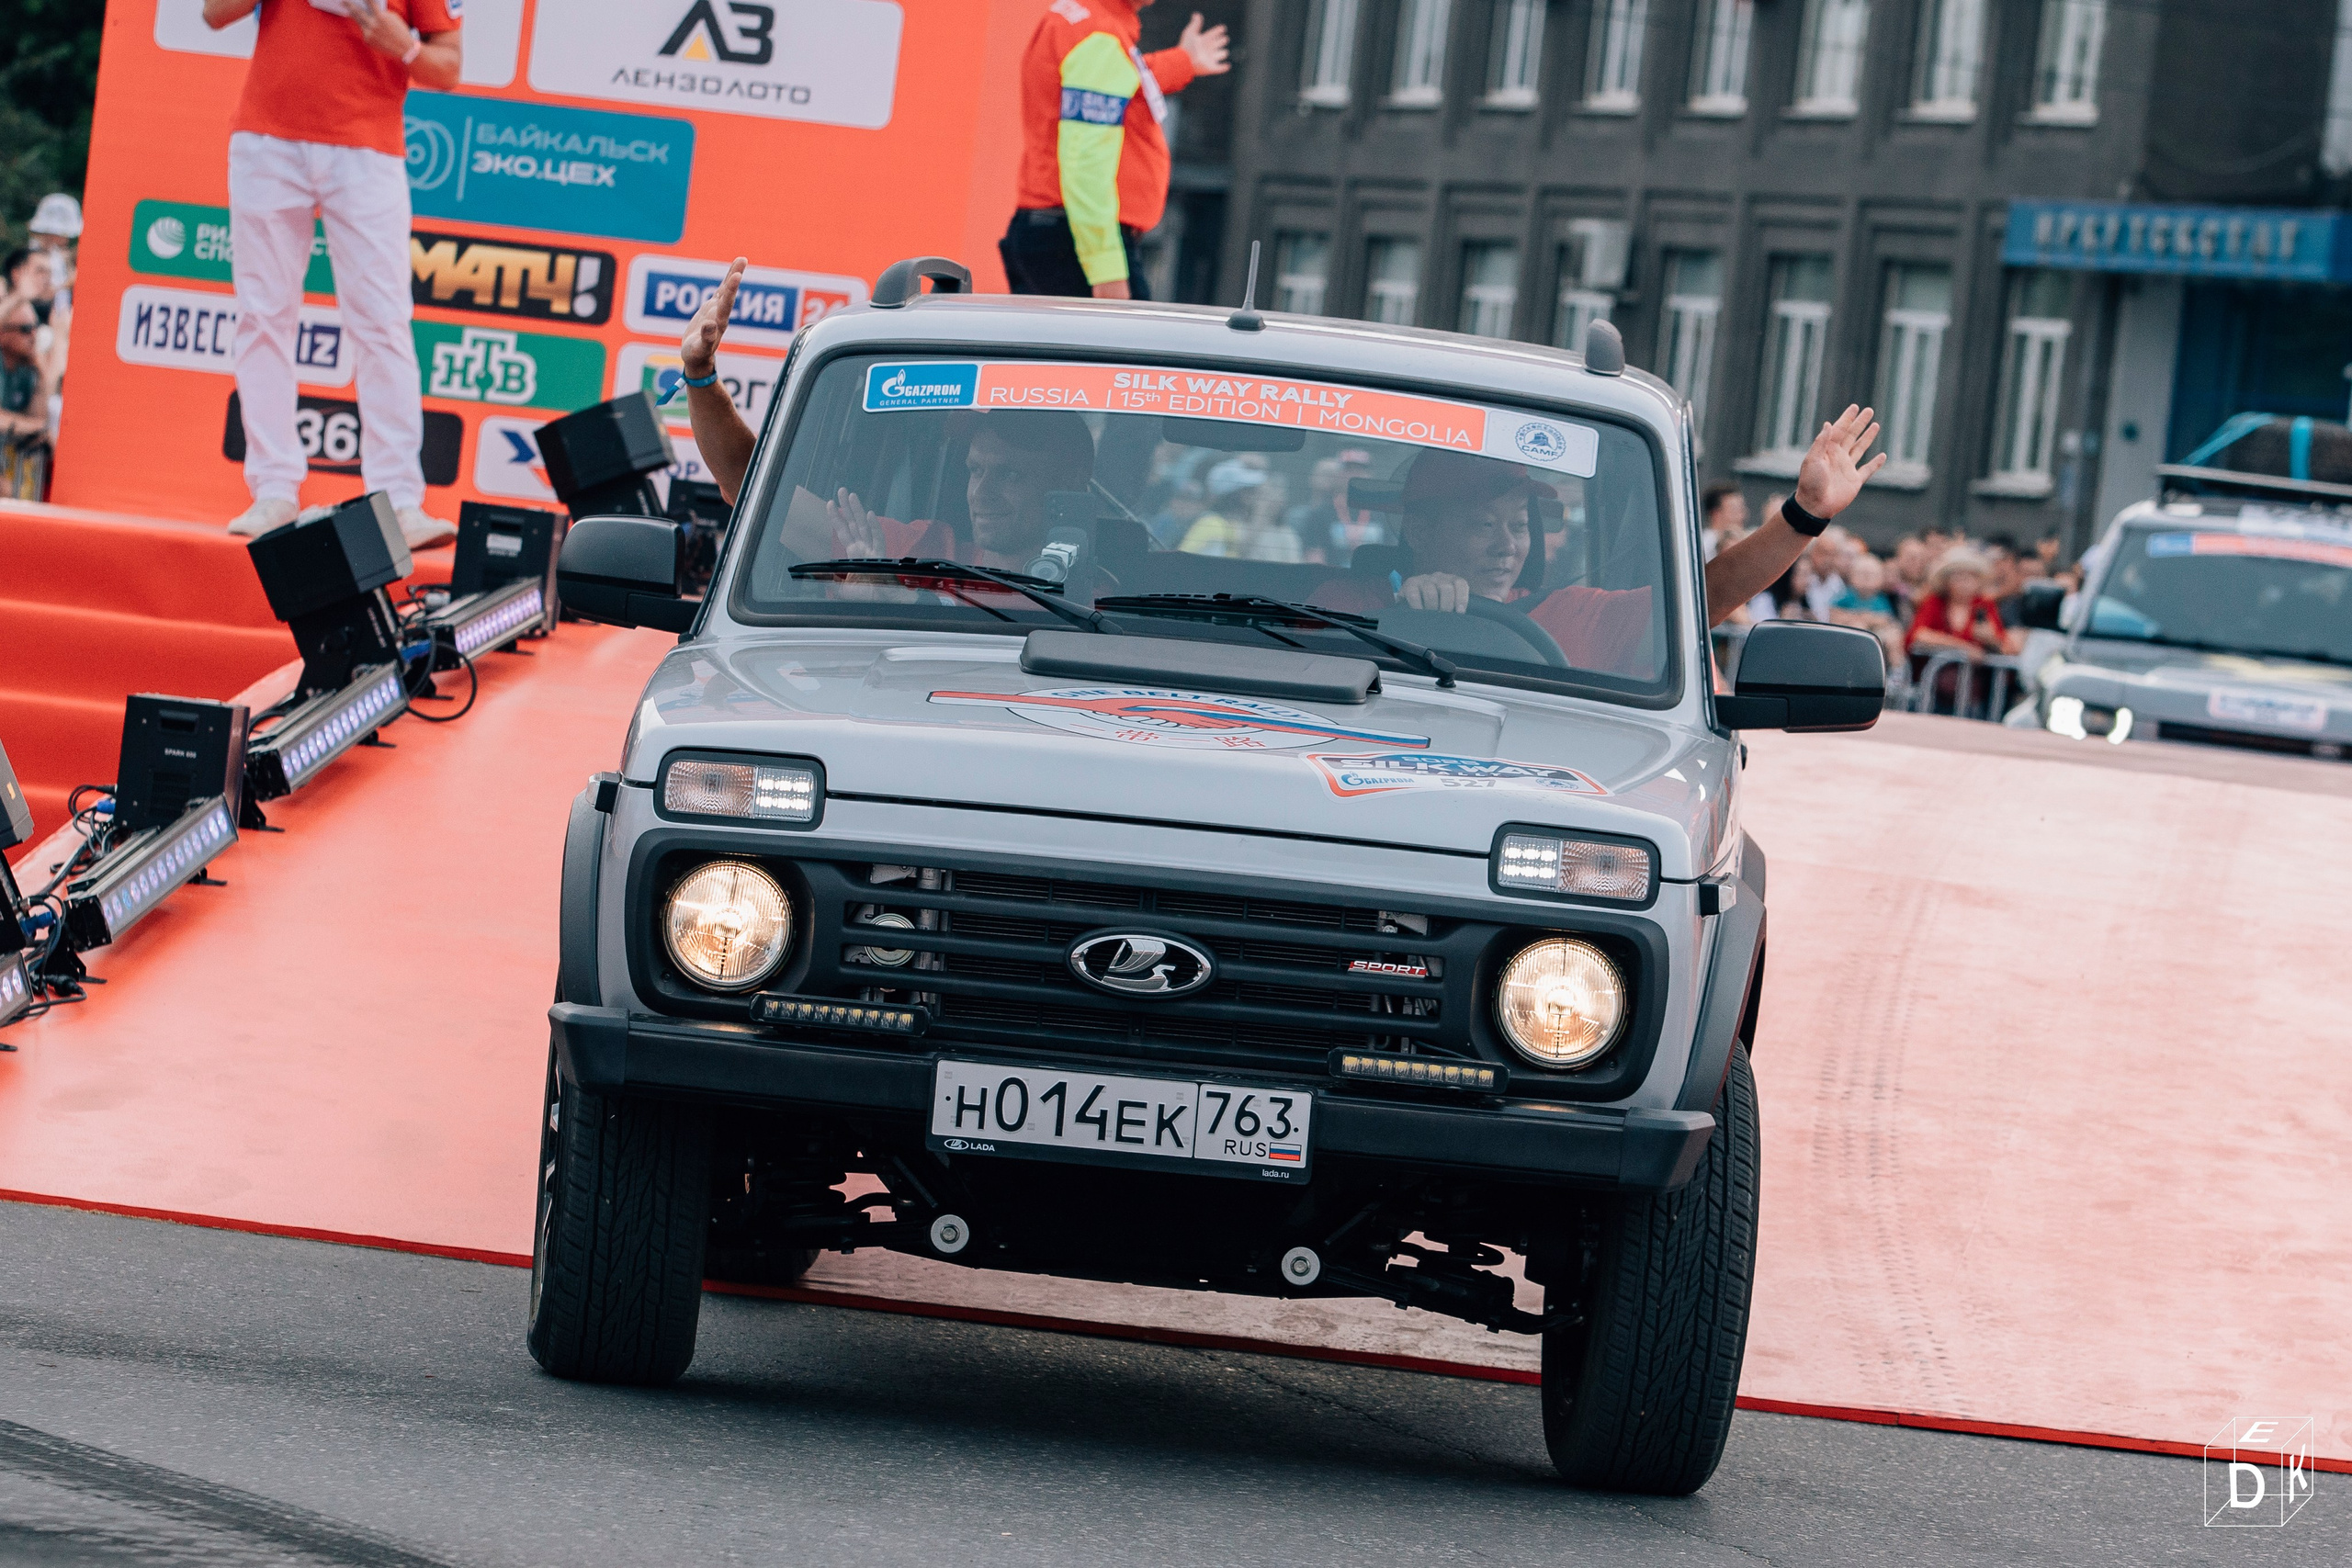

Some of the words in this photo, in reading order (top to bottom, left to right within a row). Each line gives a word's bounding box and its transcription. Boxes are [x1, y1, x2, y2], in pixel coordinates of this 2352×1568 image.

[611, 68, 811, 105] ЛЕНЗОЛОТО
[476, 123, 670, 164] БАЙКАЛЬСК
[471, 151, 616, 187] ЭКО.ЦЕХ
[197, 223, 232, 247] РИ
[411, 238, 602, 318] МАТЧ!
[655, 281, 786, 324] РОИЯ
[133, 302, 236, 356] ИЗВЕС
[434, 331, 532, 400] НТВ
[904, 384, 962, 397] GAZPROM
[989, 387, 1091, 405] RUSSIA
[1114, 372, 1178, 391] SILK
[1185, 377, 1254, 398] WAY
[1260, 384, 1353, 409] RALLY
[1120, 390, 1161, 408] 15th
[1169, 395, 1281, 420] EDITION
[1318, 409, 1474, 447] MONGOLIA
[1521, 446, 1559, 457] CAMF
[1122, 690, 1209, 700] BELT
[1213, 699, 1311, 719] RALLY
[1340, 759, 1453, 772] SILK
[1457, 765, 1558, 777] WAY
[1363, 777, 1415, 785] GAZPROM
[1440, 778, 1498, 787] 527
[1353, 960, 1426, 976] SPORT
[1205, 1090, 1294, 1139] 763
[970, 1143, 995, 1152] LADA
[1224, 1139, 1266, 1157] RUS
[1261, 1168, 1290, 1179] lada.ru
